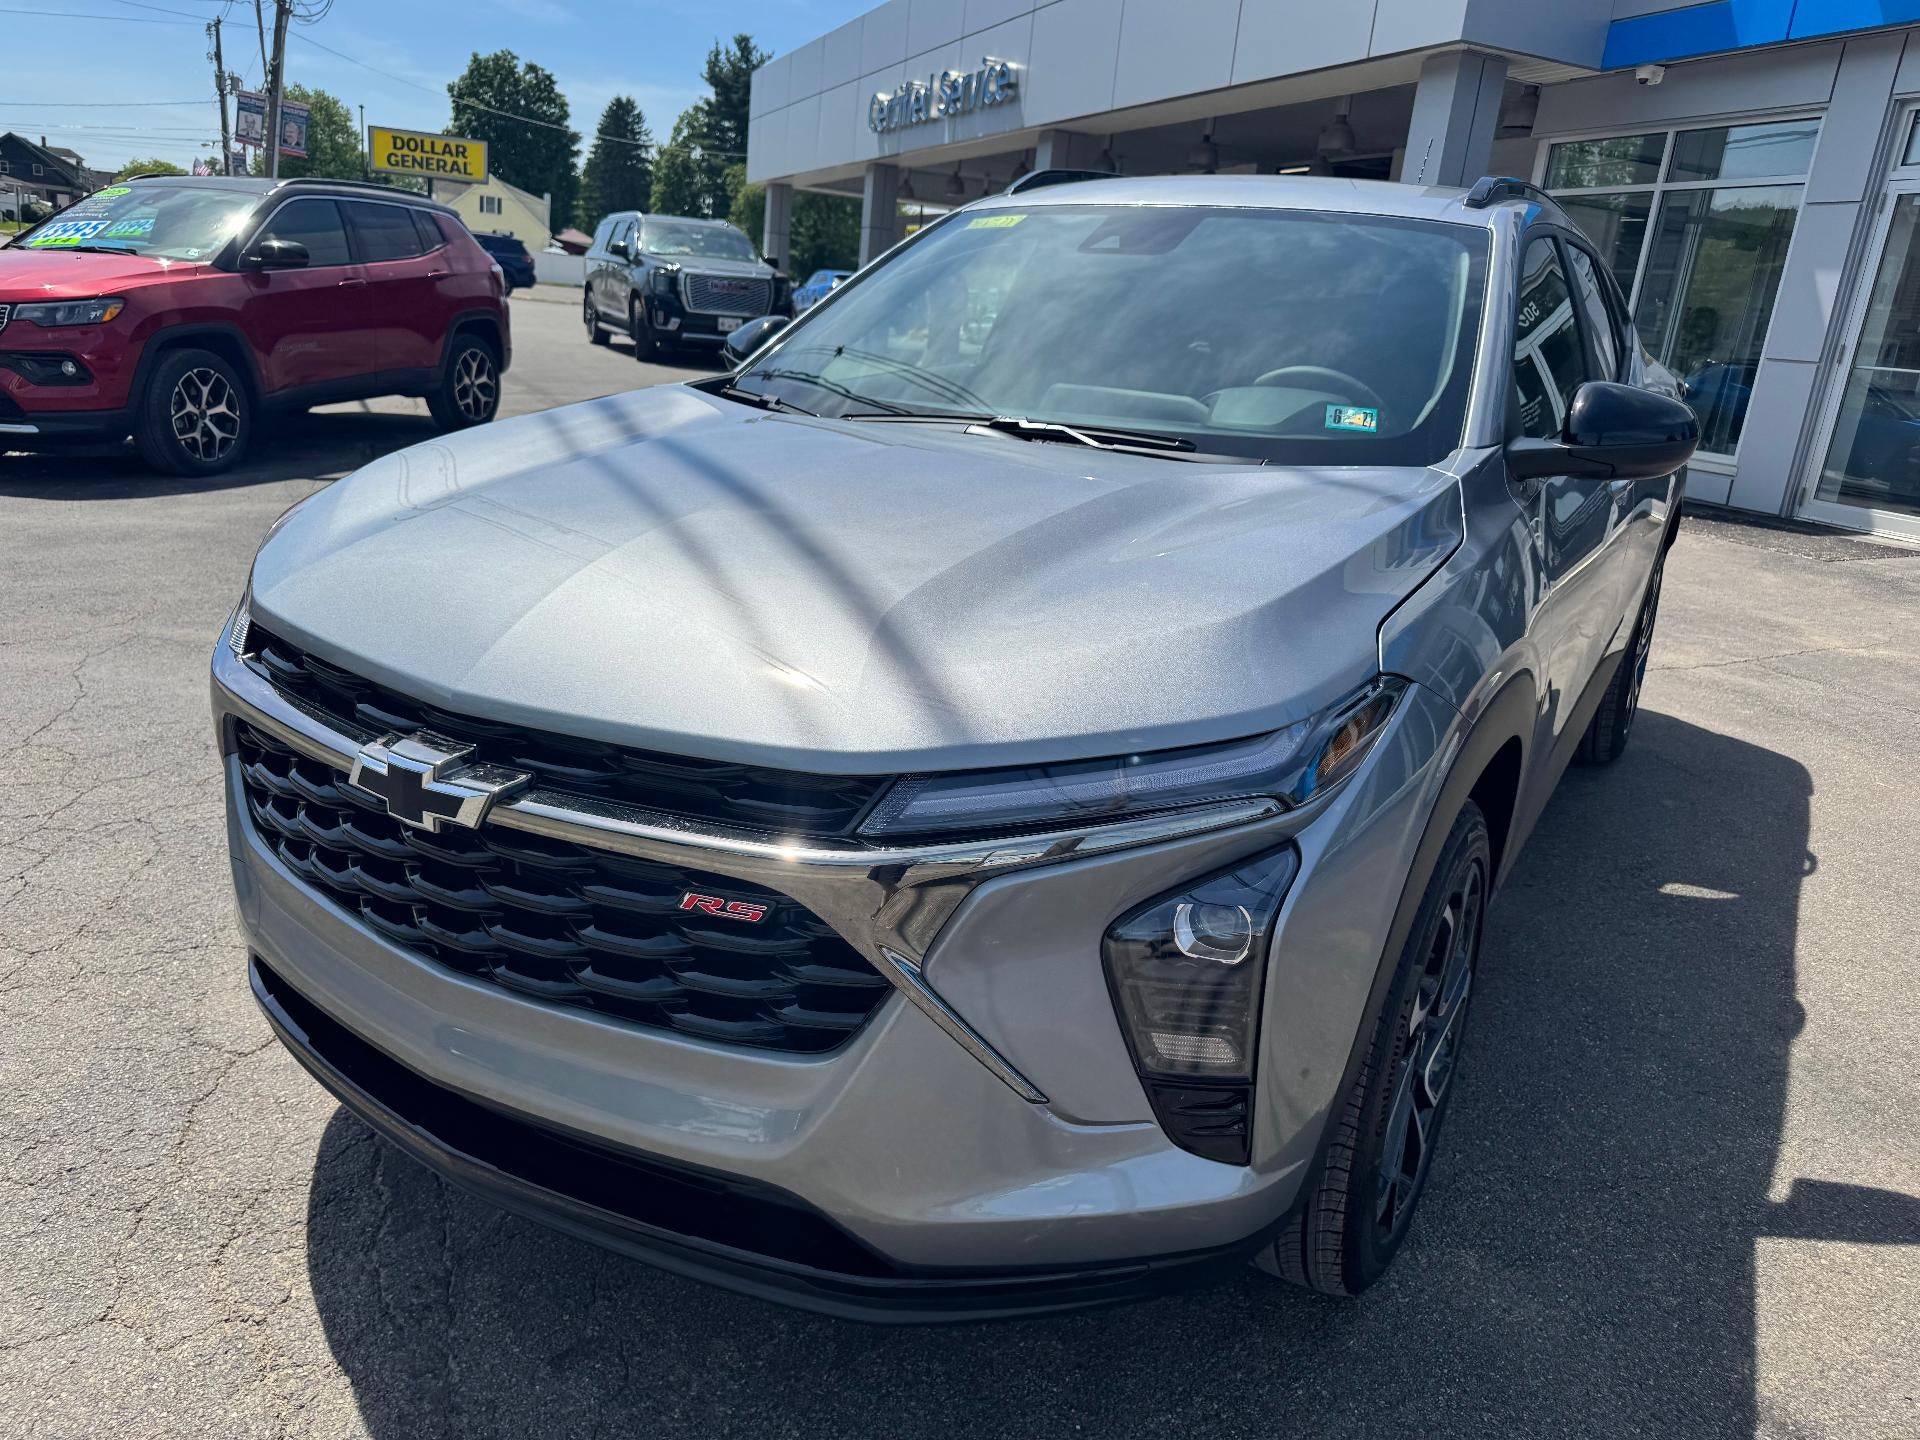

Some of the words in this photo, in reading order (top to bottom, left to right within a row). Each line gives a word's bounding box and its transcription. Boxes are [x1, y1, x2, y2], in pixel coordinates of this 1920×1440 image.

[869, 73, 934, 133] Certified
[937, 56, 1019, 116] Service
[391, 134, 468, 159] DOLLAR
[386, 152, 473, 176] GENERAL
[1333, 408, 1342, 424] 6
[1362, 411, 1374, 428] 27
[680, 891, 768, 922] RS
